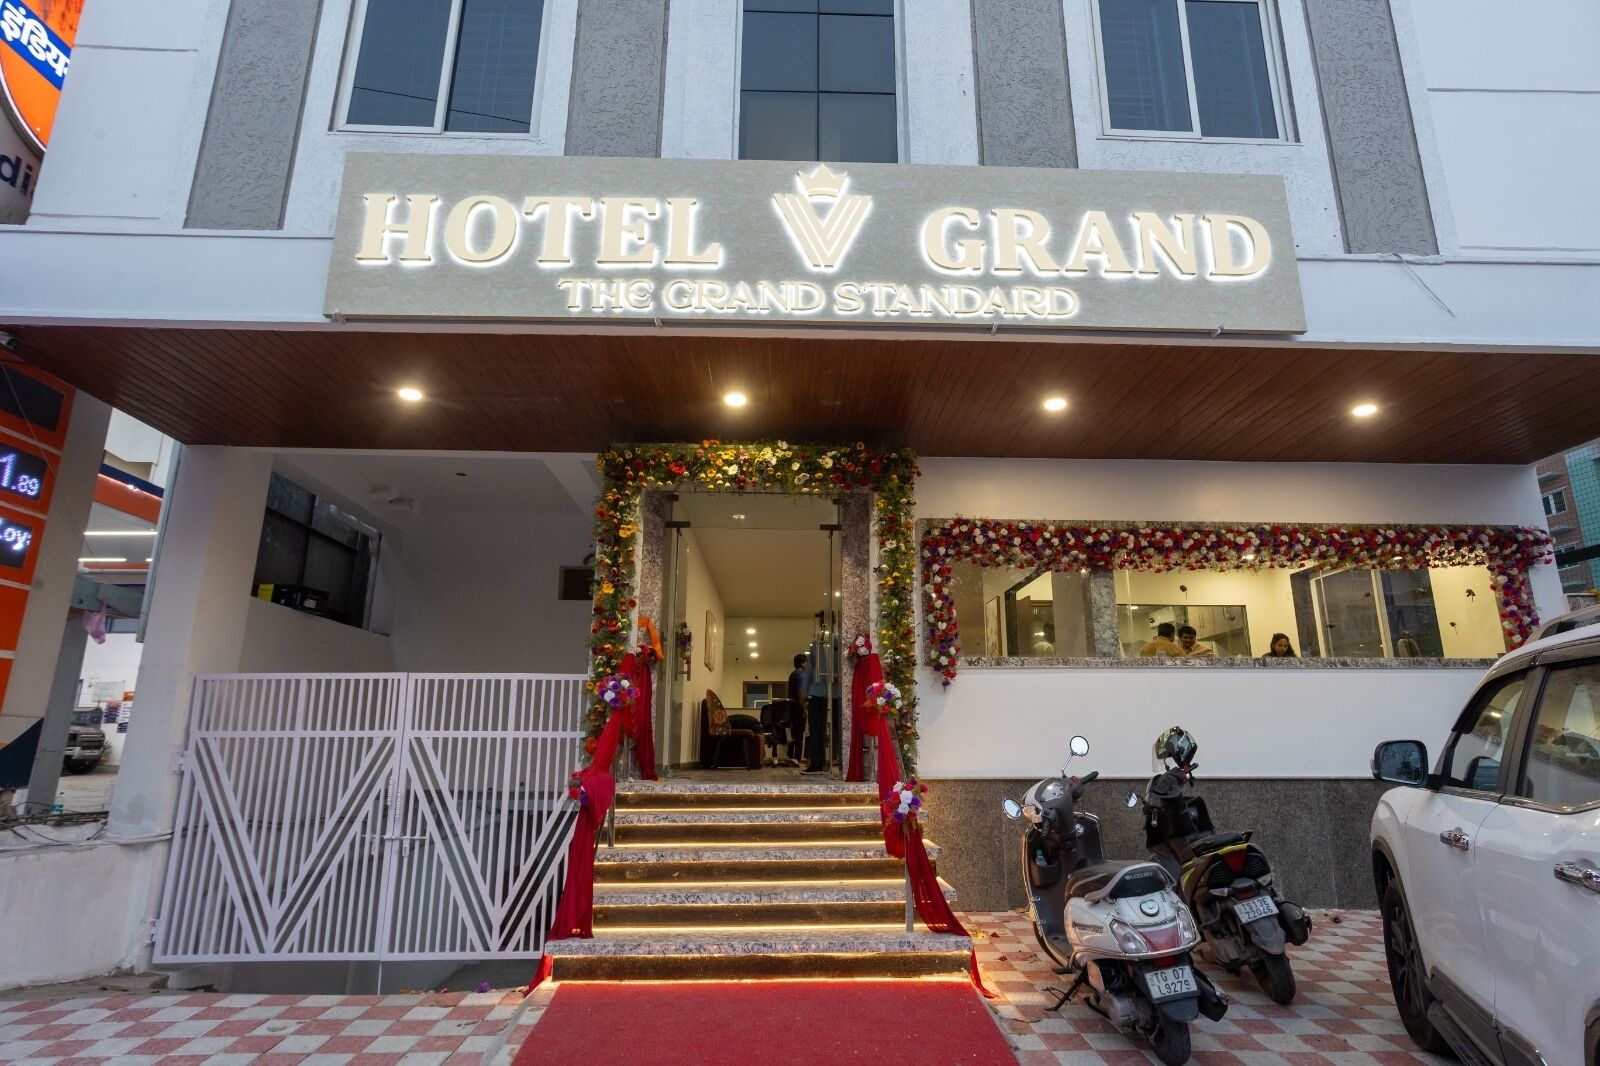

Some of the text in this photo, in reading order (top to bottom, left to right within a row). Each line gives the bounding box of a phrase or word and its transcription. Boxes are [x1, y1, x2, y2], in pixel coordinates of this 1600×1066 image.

[355, 192, 721, 268] HOTEL
[921, 206, 1273, 280] GRAND
[558, 277, 1079, 317] THE GRAND STANDARD
[1153, 967, 1185, 983] TG 07
[1157, 979, 1191, 996] L9279
